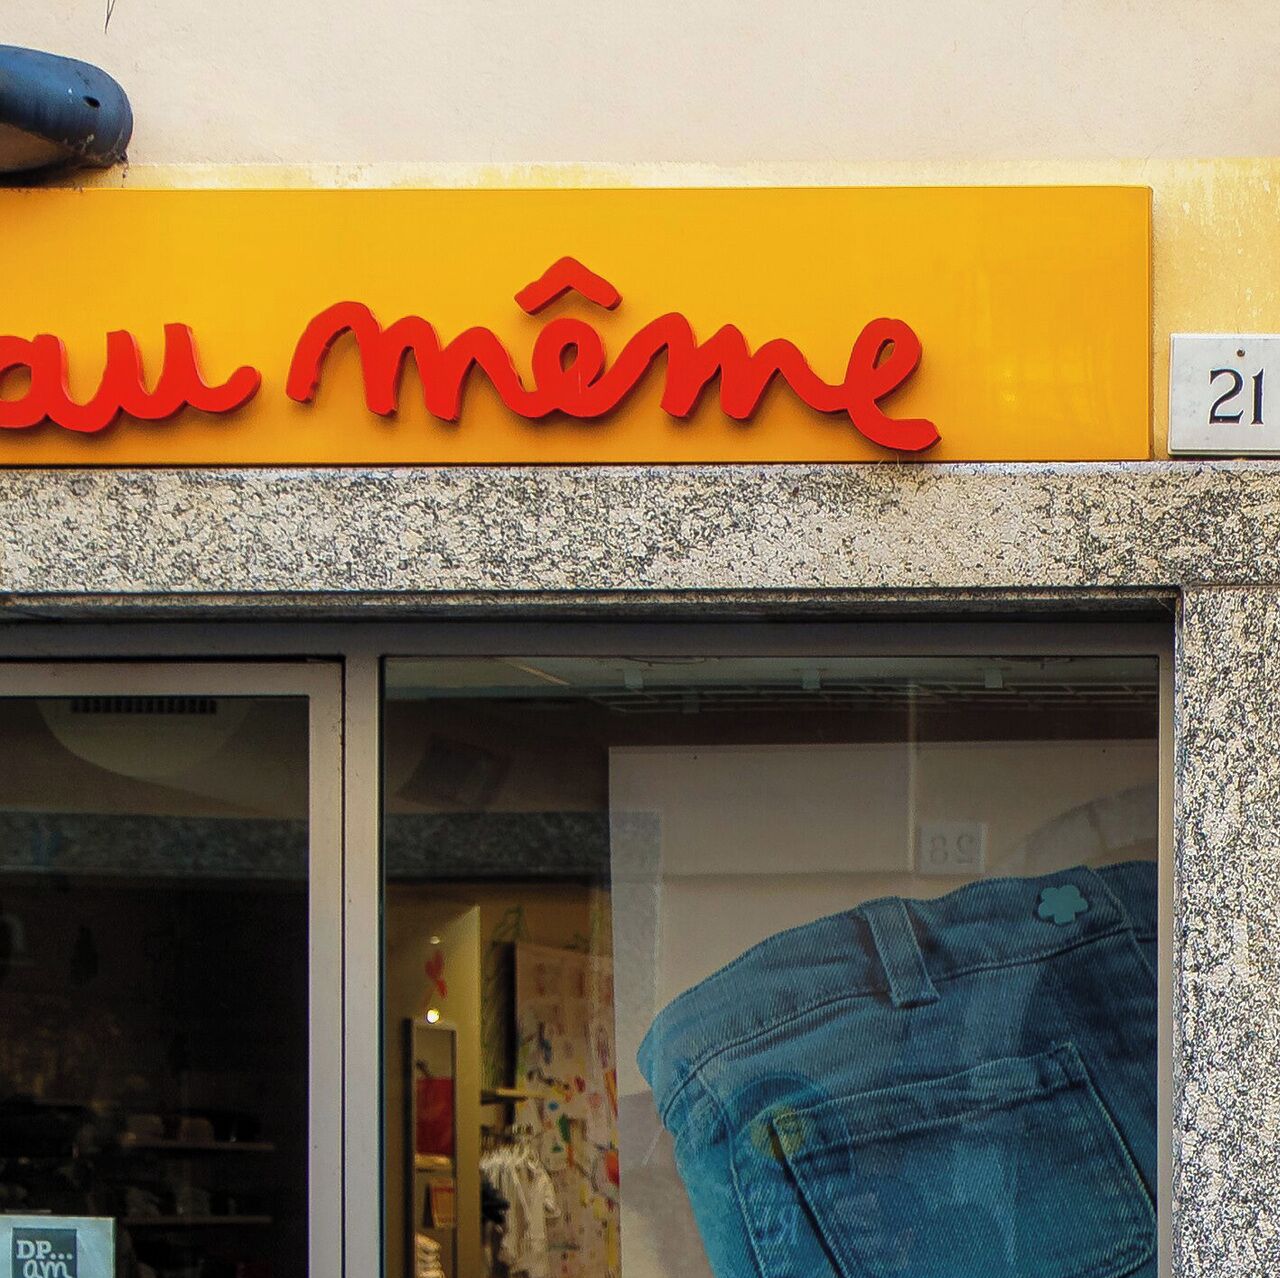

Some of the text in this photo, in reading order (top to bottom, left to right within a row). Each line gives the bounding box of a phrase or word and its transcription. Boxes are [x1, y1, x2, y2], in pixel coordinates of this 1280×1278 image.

[0, 256, 942, 451] au même
[1208, 367, 1265, 426] 21
